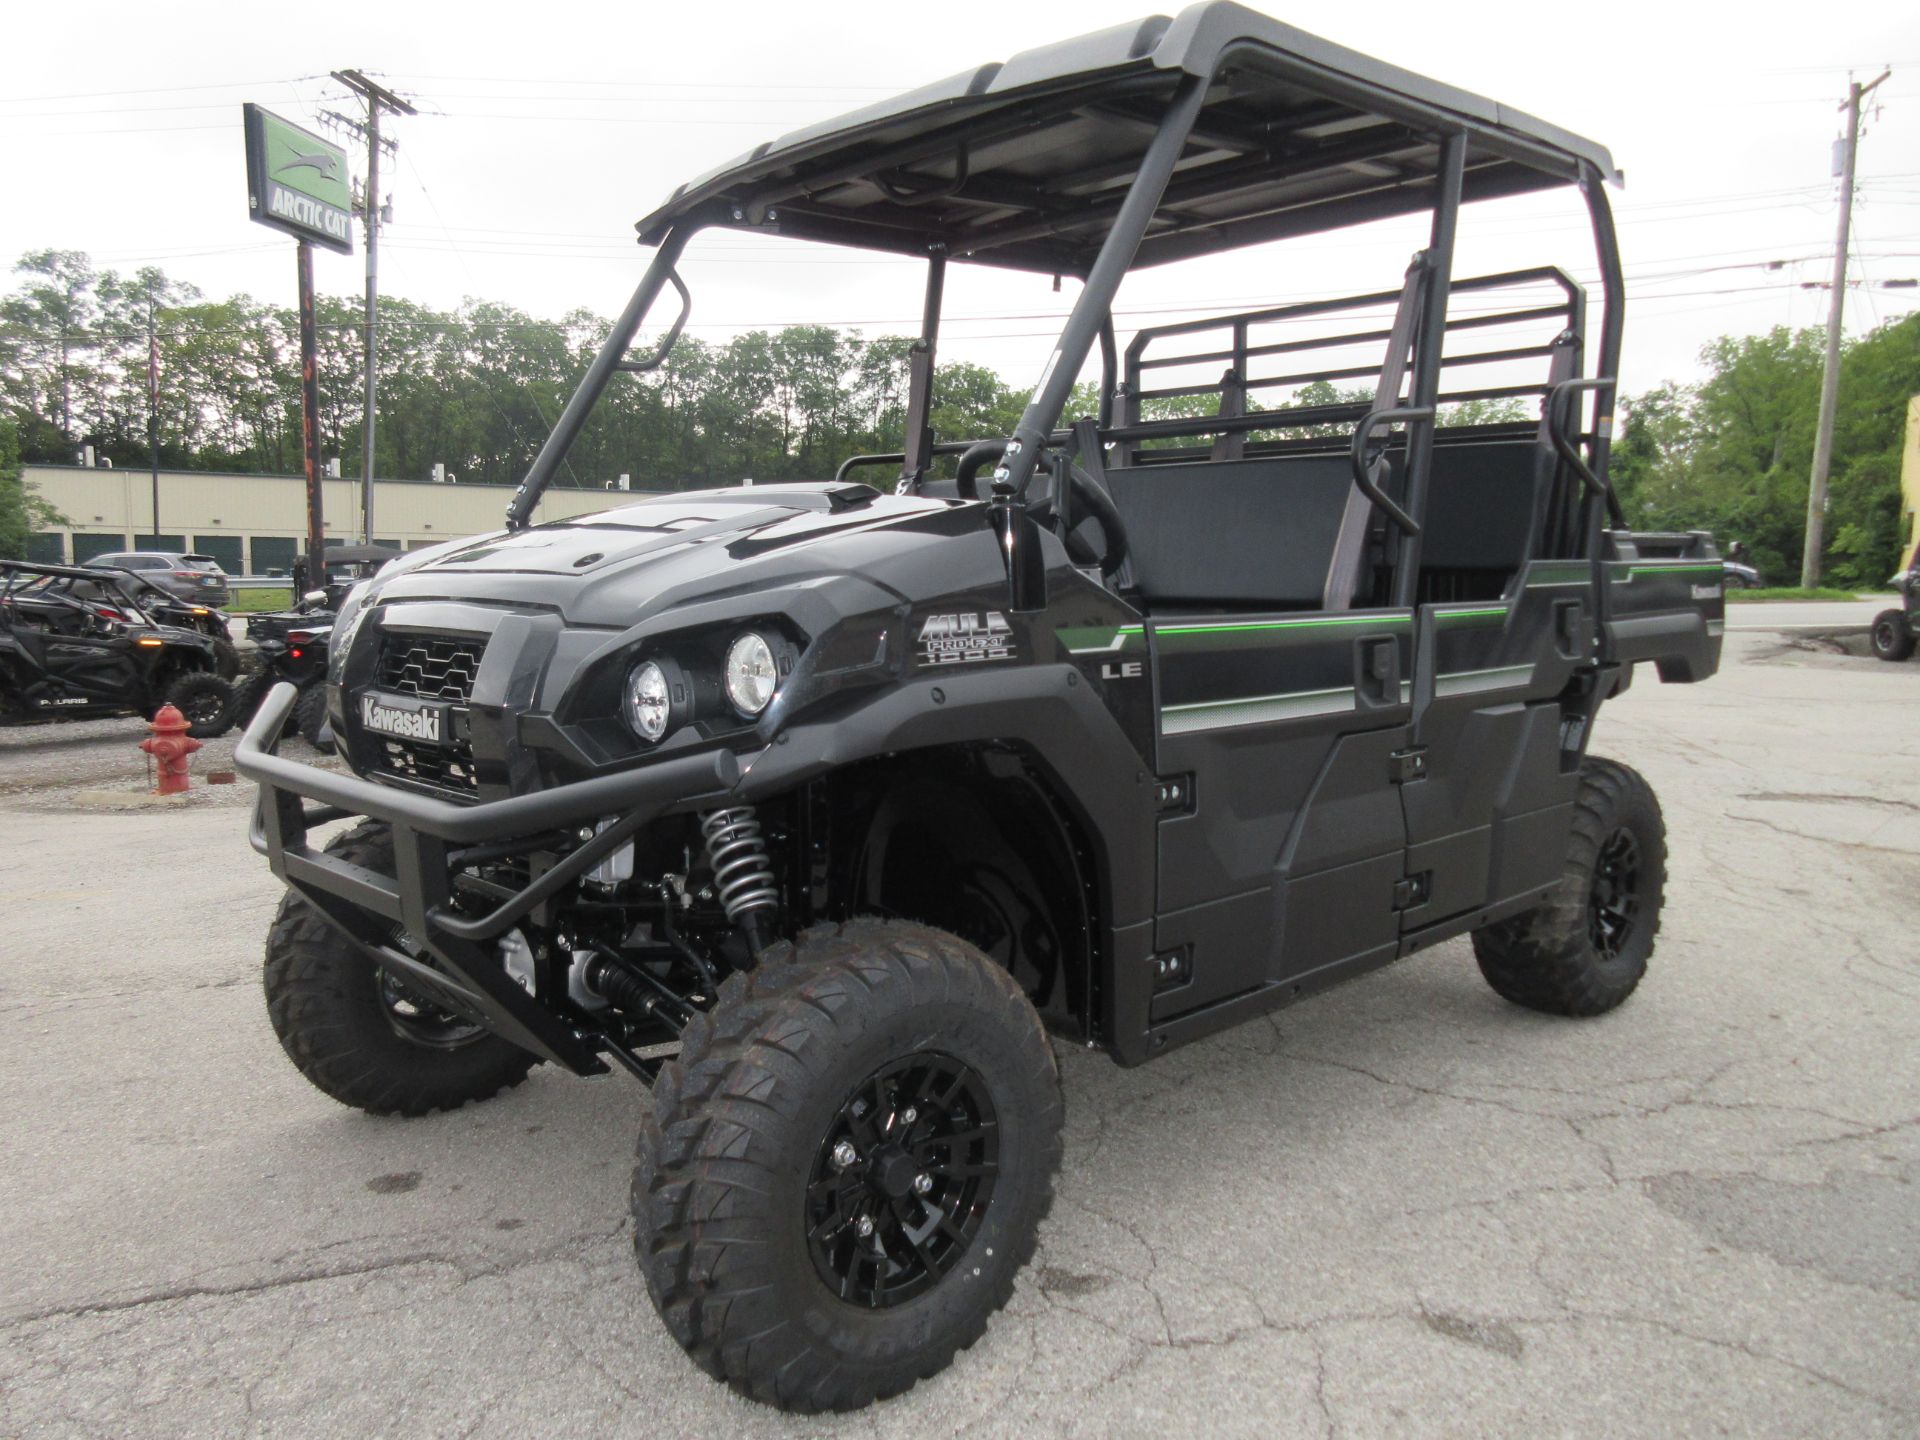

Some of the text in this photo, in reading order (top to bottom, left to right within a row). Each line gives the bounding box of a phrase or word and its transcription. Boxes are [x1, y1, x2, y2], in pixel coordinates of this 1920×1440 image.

[272, 187, 348, 239] ARCTIC CAT
[918, 611, 1014, 642] MULE
[927, 648, 1009, 663] 1000
[1101, 662, 1142, 680] LE
[39, 697, 89, 706] PLARIS
[363, 697, 440, 741] Kawasaki
